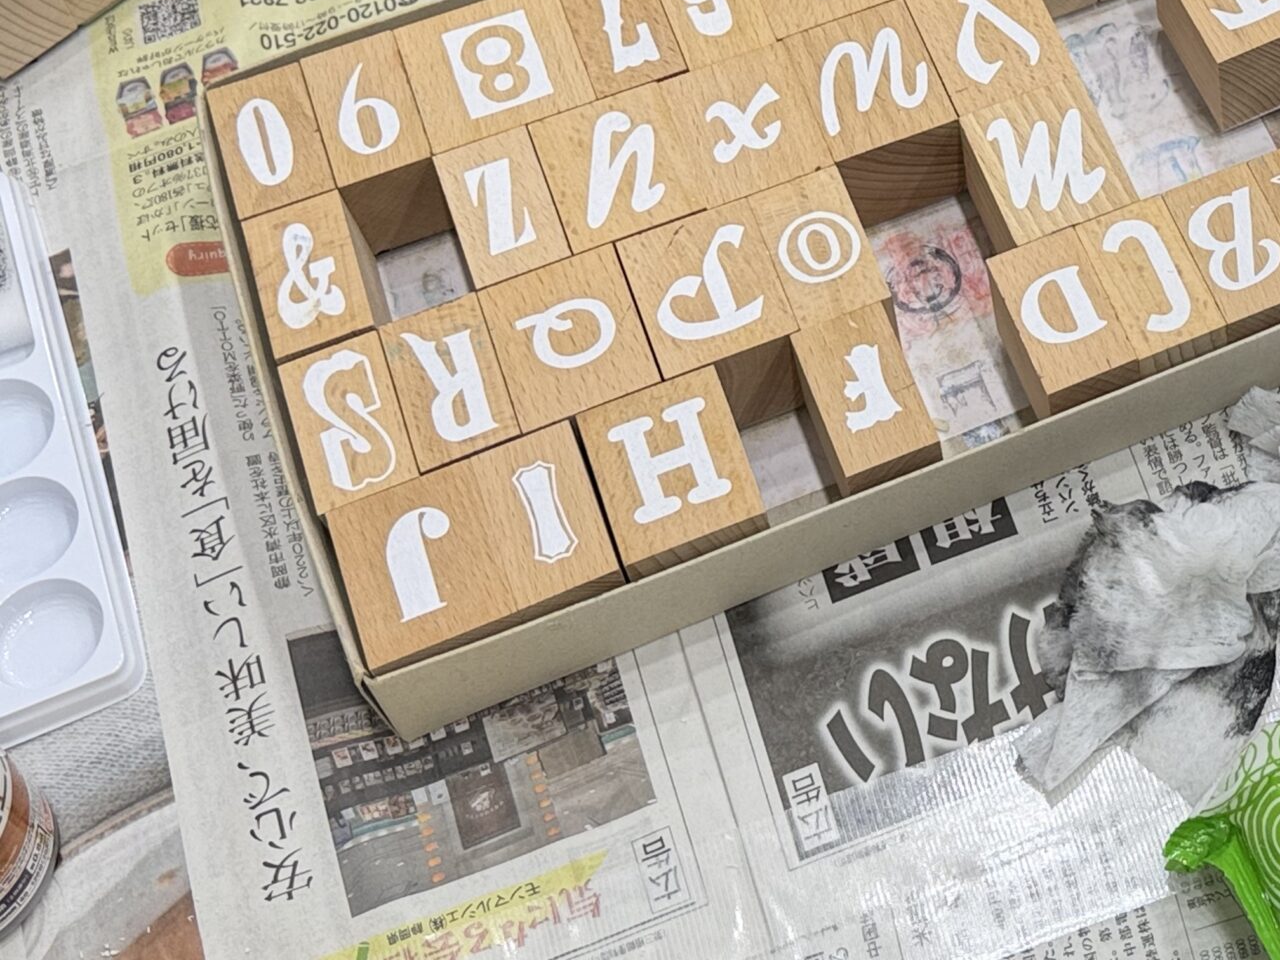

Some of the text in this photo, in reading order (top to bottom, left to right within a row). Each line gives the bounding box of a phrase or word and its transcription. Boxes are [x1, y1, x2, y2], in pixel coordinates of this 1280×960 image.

[449, 15, 543, 112] 8
[463, 157, 539, 257] Z
[276, 222, 349, 331] &
[1020, 265, 1108, 347] D
[301, 347, 400, 494] S
[398, 329, 500, 445] R
[843, 343, 905, 436] F
[607, 396, 735, 527] H
[385, 505, 452, 624] J
[640, 830, 685, 910] 広告
